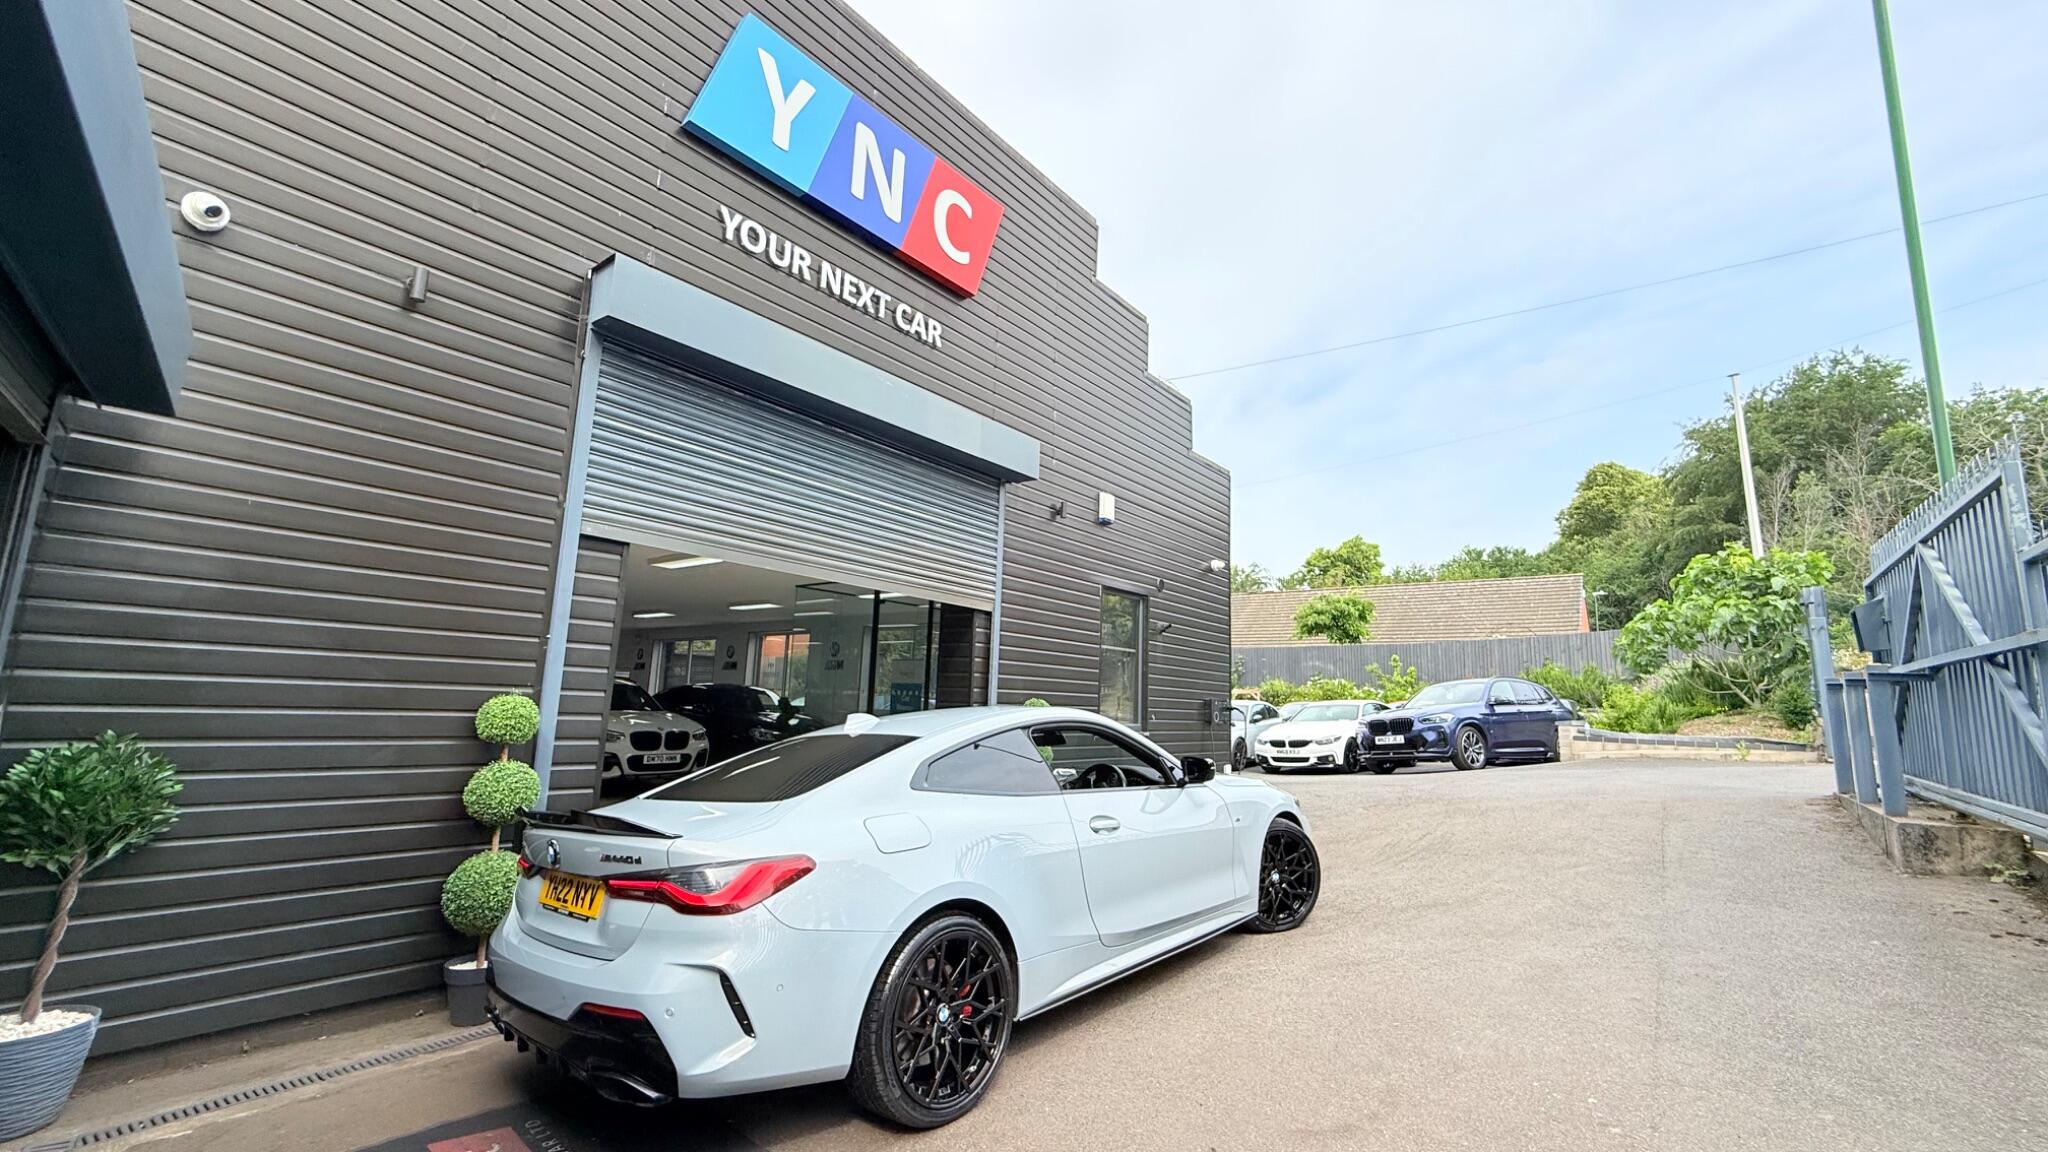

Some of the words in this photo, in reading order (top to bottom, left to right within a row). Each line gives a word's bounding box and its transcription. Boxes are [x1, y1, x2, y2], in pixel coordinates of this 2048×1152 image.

[757, 46, 973, 265] YNC
[719, 204, 812, 282] YOUR
[819, 260, 892, 318] NEXT
[895, 302, 944, 348] CAR
[571, 879, 601, 911] NYV
[524, 1119, 551, 1139] LTD
